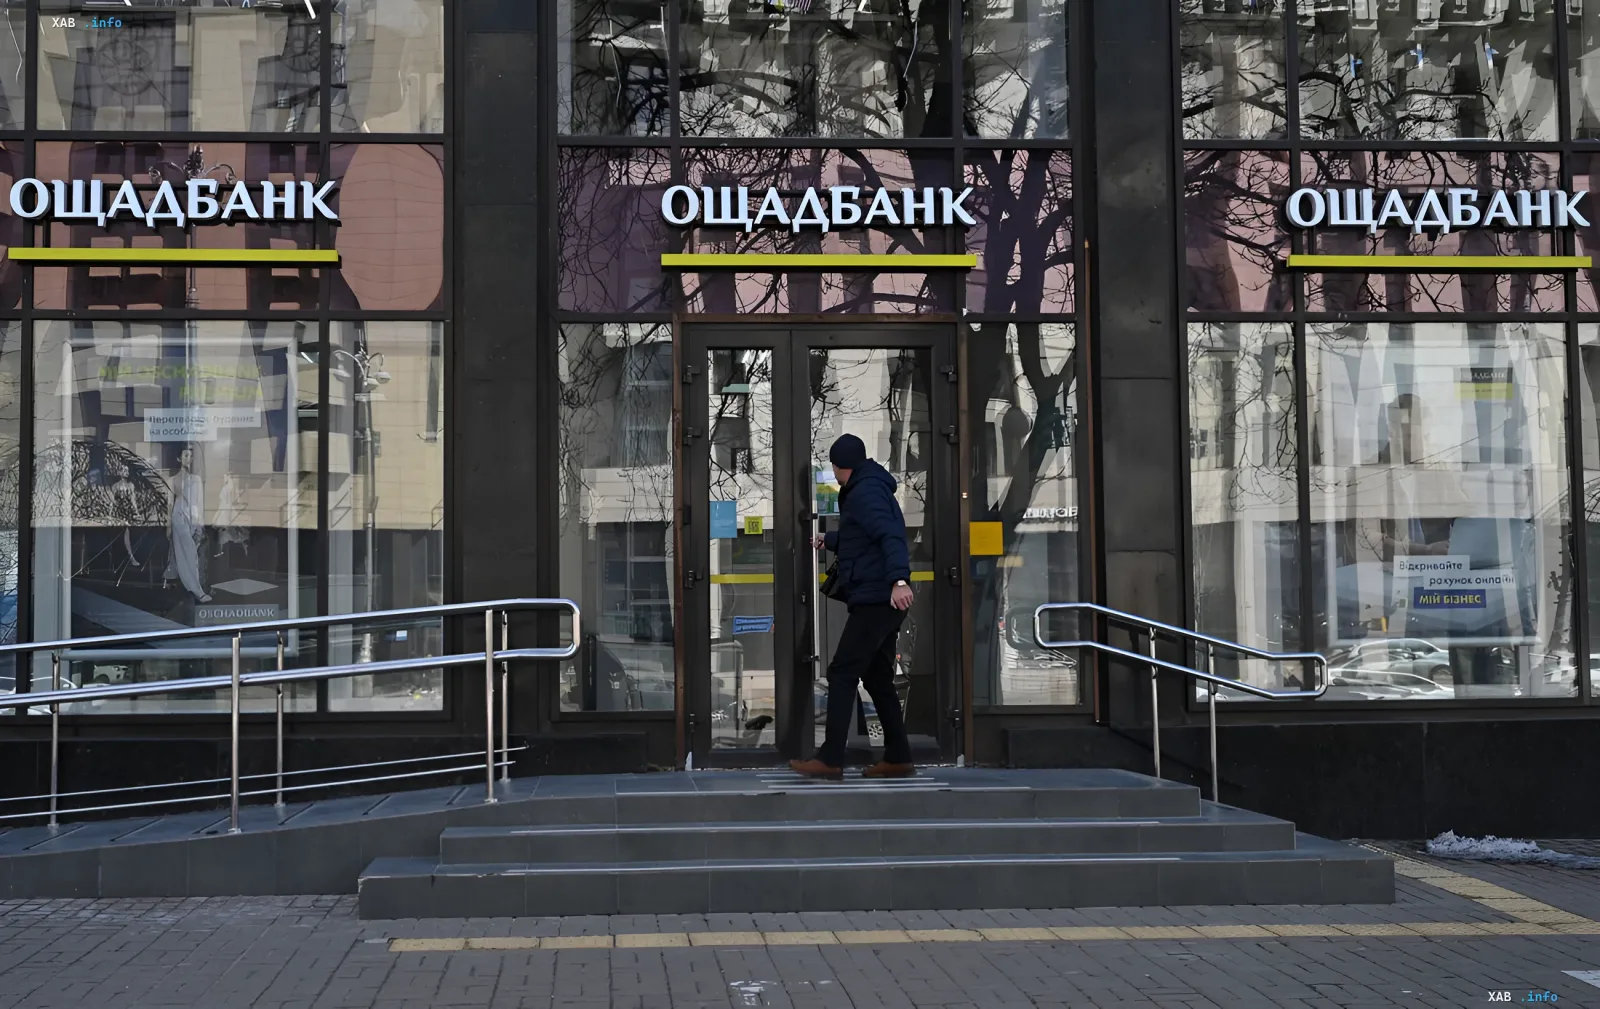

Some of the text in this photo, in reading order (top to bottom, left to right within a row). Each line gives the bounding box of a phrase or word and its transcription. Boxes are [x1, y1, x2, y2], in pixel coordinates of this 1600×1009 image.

[9, 178, 339, 228] ОЩАДБАНК
[661, 185, 977, 233] ОЩАДБАНК
[1286, 188, 1591, 234] ОЩАДБАНК
[1399, 561, 1463, 572] Відкривайте
[1429, 577, 1472, 587] рахунок
[1419, 593, 1482, 604] МІЙ БІЗНЕС
